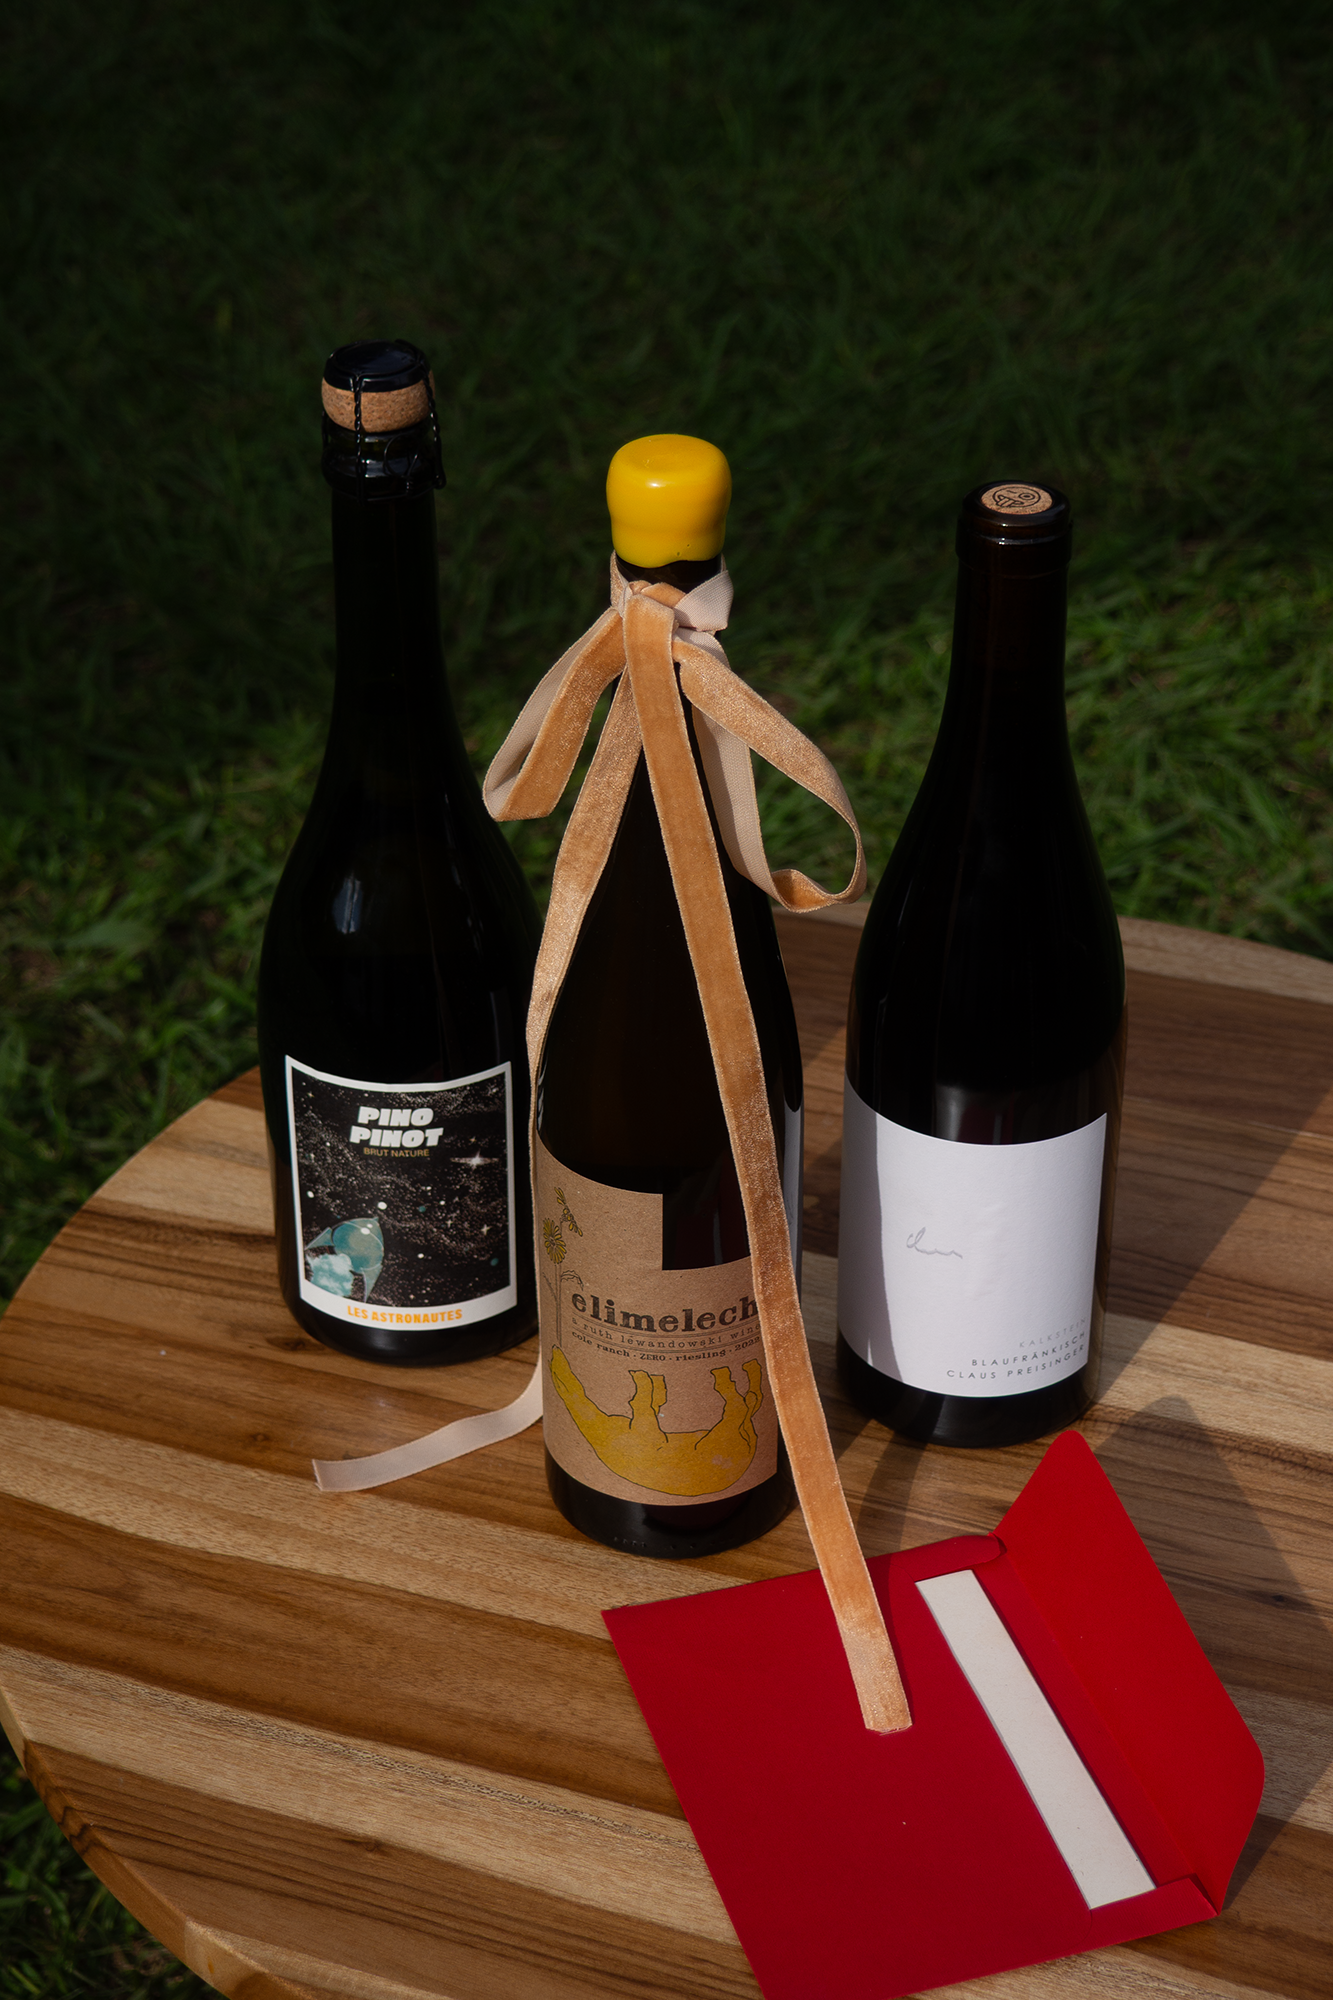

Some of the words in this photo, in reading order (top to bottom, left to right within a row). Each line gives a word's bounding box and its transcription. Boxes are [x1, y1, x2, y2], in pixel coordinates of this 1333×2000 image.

[357, 1105, 434, 1127] PINO
[349, 1125, 444, 1148] PINOT
[363, 1147, 389, 1157] BRUT
[391, 1149, 430, 1158] NATURE
[347, 1305, 369, 1320] LES
[371, 1309, 463, 1324] ASTRONAUTES
[571, 1292, 759, 1333] elimelech
[571, 1317, 578, 1325] a
[583, 1323, 613, 1340] ruth
[620, 1334, 722, 1349] lewandowski
[571, 1331, 593, 1346] cole
[596, 1343, 630, 1358] ranch
[639, 1353, 666, 1362] ZERO
[675, 1349, 727, 1362] riesling
[1019, 1317, 1086, 1348] KALKSTEIN
[946, 1369, 997, 1379] CLAUS
[1006, 1344, 1084, 1377] PREISINGER
[971, 1331, 1085, 1366] BLAUFRÄNKISCH
